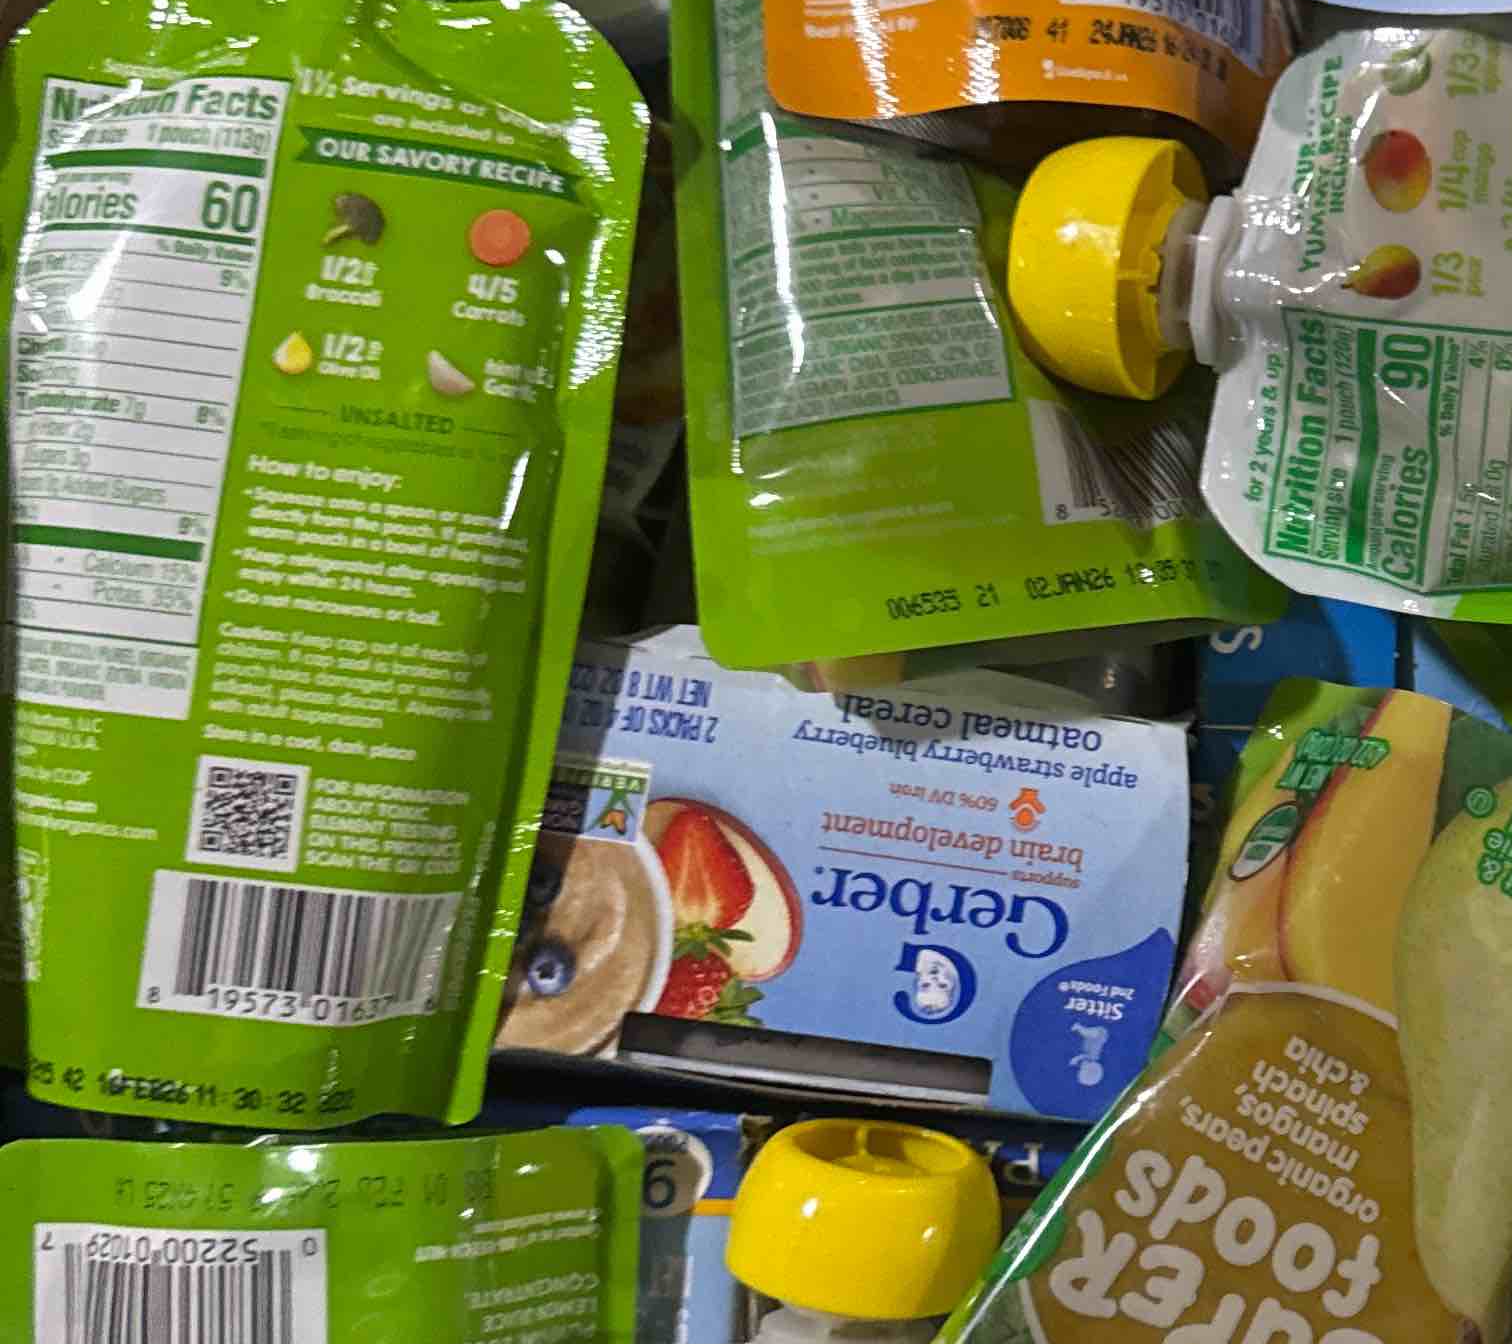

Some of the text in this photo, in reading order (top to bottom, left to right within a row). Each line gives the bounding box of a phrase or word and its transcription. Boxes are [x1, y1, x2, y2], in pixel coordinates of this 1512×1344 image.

[317, 137, 567, 193] OUR SAVORY RECIPE
[202, 180, 260, 232] 60
[1245, 353, 1283, 502] for 2 years & up
[1274, 317, 1335, 555] Nutrition Facts
[1380, 332, 1432, 582] Calories 90
[791, 718, 1138, 791] apple strawberry blueberry
[839, 693, 1103, 752] oatmeal cereal
[930, 789, 955, 806] DV
[958, 793, 998, 812] 60%
[818, 807, 1084, 871] brain development
[1062, 995, 1124, 1021] Sitter
[1233, 1090, 1361, 1172] mangos,
[1243, 1056, 1375, 1138] spinach
[1178, 1093, 1381, 1225] organic pears,
